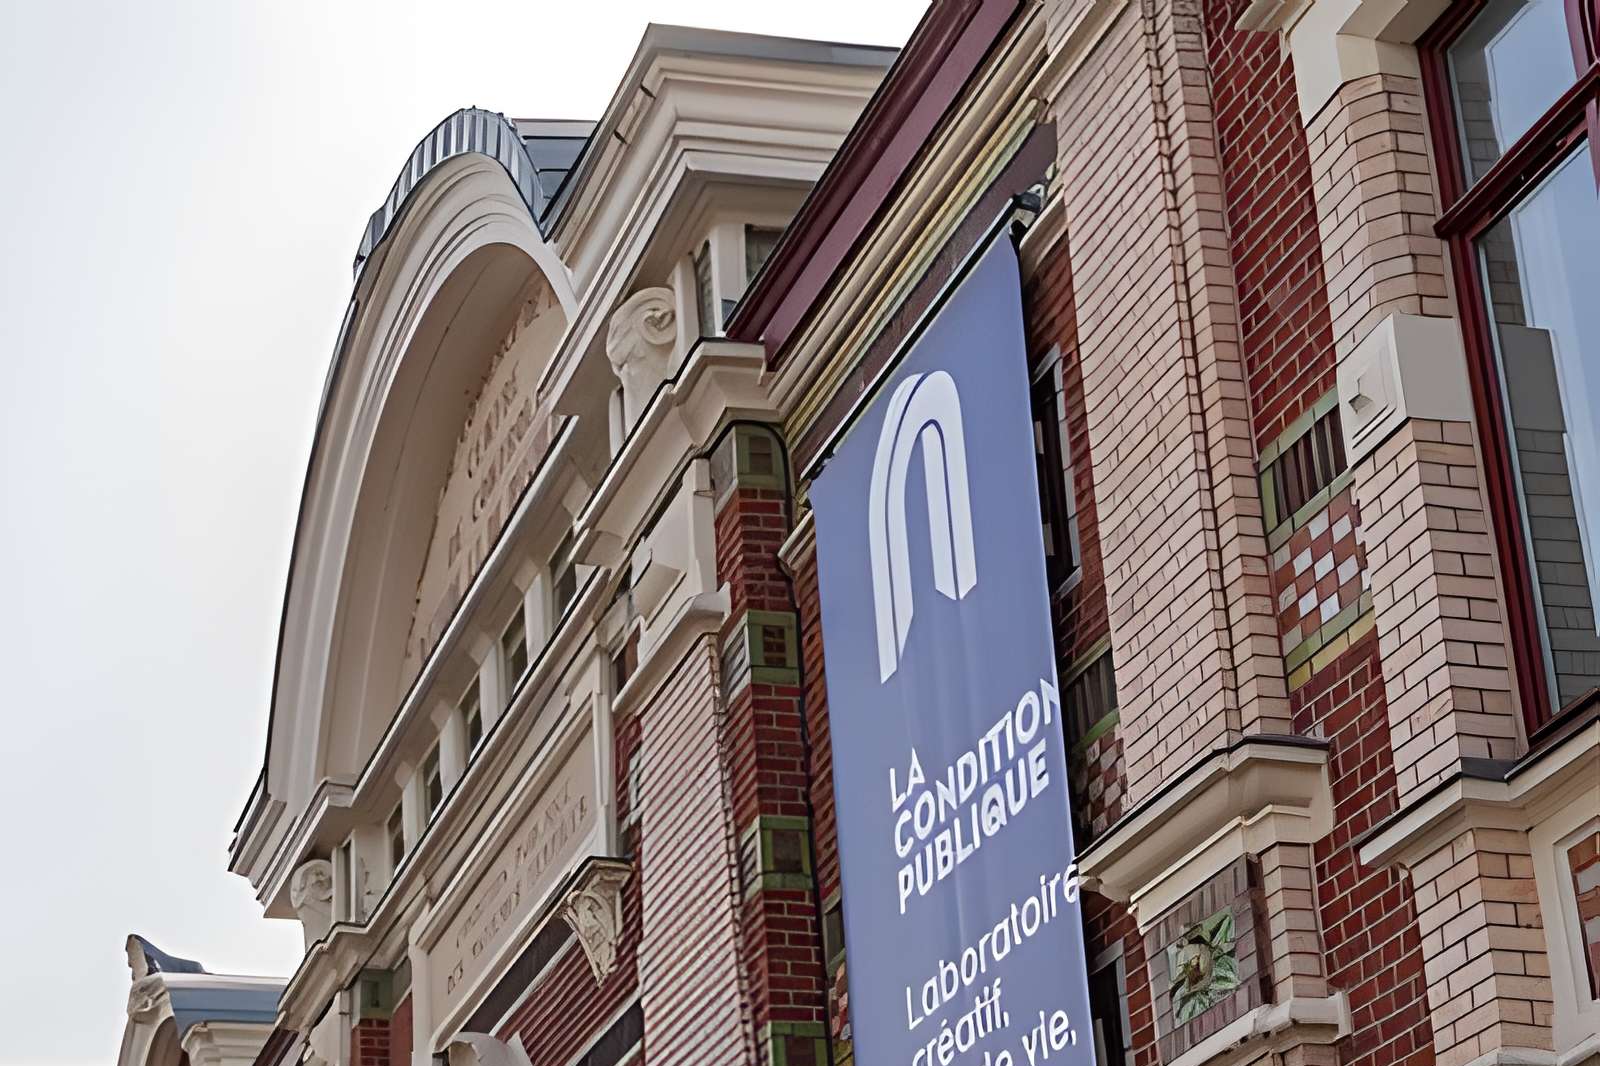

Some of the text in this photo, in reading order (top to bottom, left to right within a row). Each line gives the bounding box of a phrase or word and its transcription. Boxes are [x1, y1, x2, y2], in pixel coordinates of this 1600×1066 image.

[890, 747, 925, 813] LA
[895, 678, 1060, 858] CONDITION
[898, 738, 1049, 915] PUBLIQUE
[906, 863, 1080, 1031] Laboratoire
